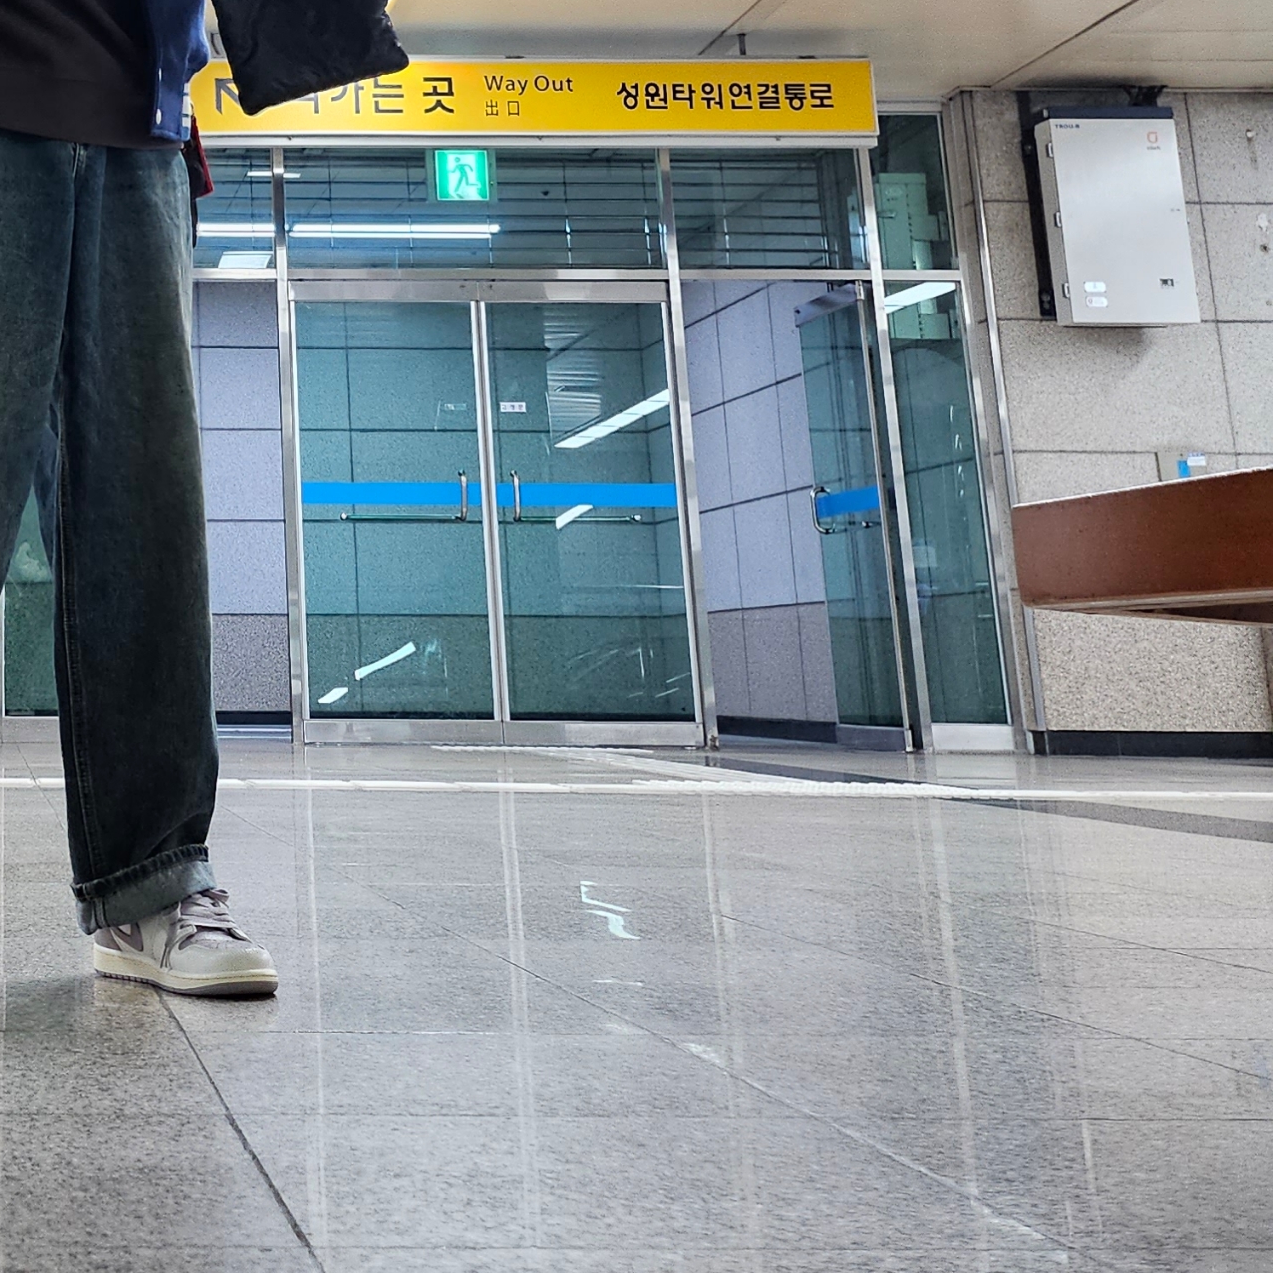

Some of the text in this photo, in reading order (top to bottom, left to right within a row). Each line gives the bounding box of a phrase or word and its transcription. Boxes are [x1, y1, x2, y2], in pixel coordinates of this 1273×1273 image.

[422, 76, 456, 115] 곳
[484, 75, 574, 95] Way Out
[616, 81, 834, 112] 성원타워연결통로
[484, 100, 521, 117] 出口
